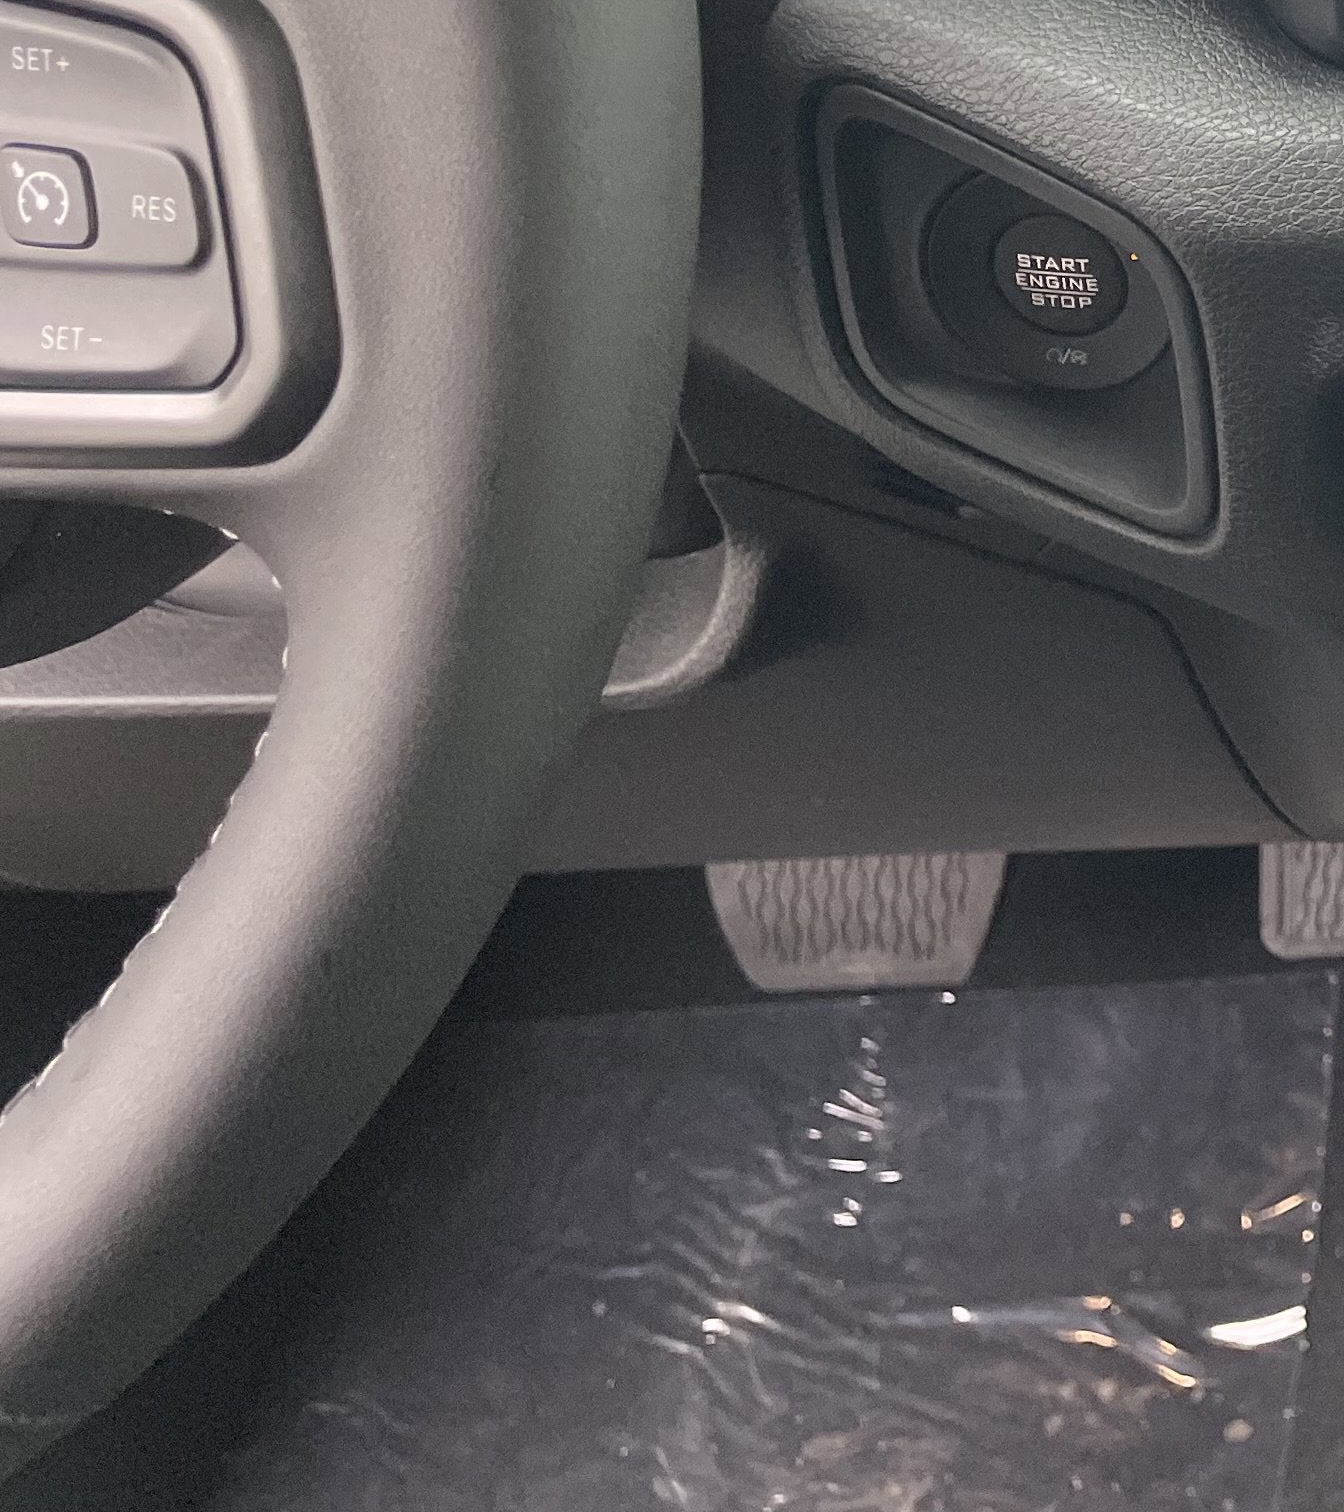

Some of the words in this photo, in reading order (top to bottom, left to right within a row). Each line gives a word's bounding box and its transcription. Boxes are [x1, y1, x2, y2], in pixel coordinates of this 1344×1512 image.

[132, 194, 177, 222] RES
[1016, 253, 1090, 273] START
[1015, 272, 1099, 292] ENGINE
[1031, 292, 1093, 309] STOP
